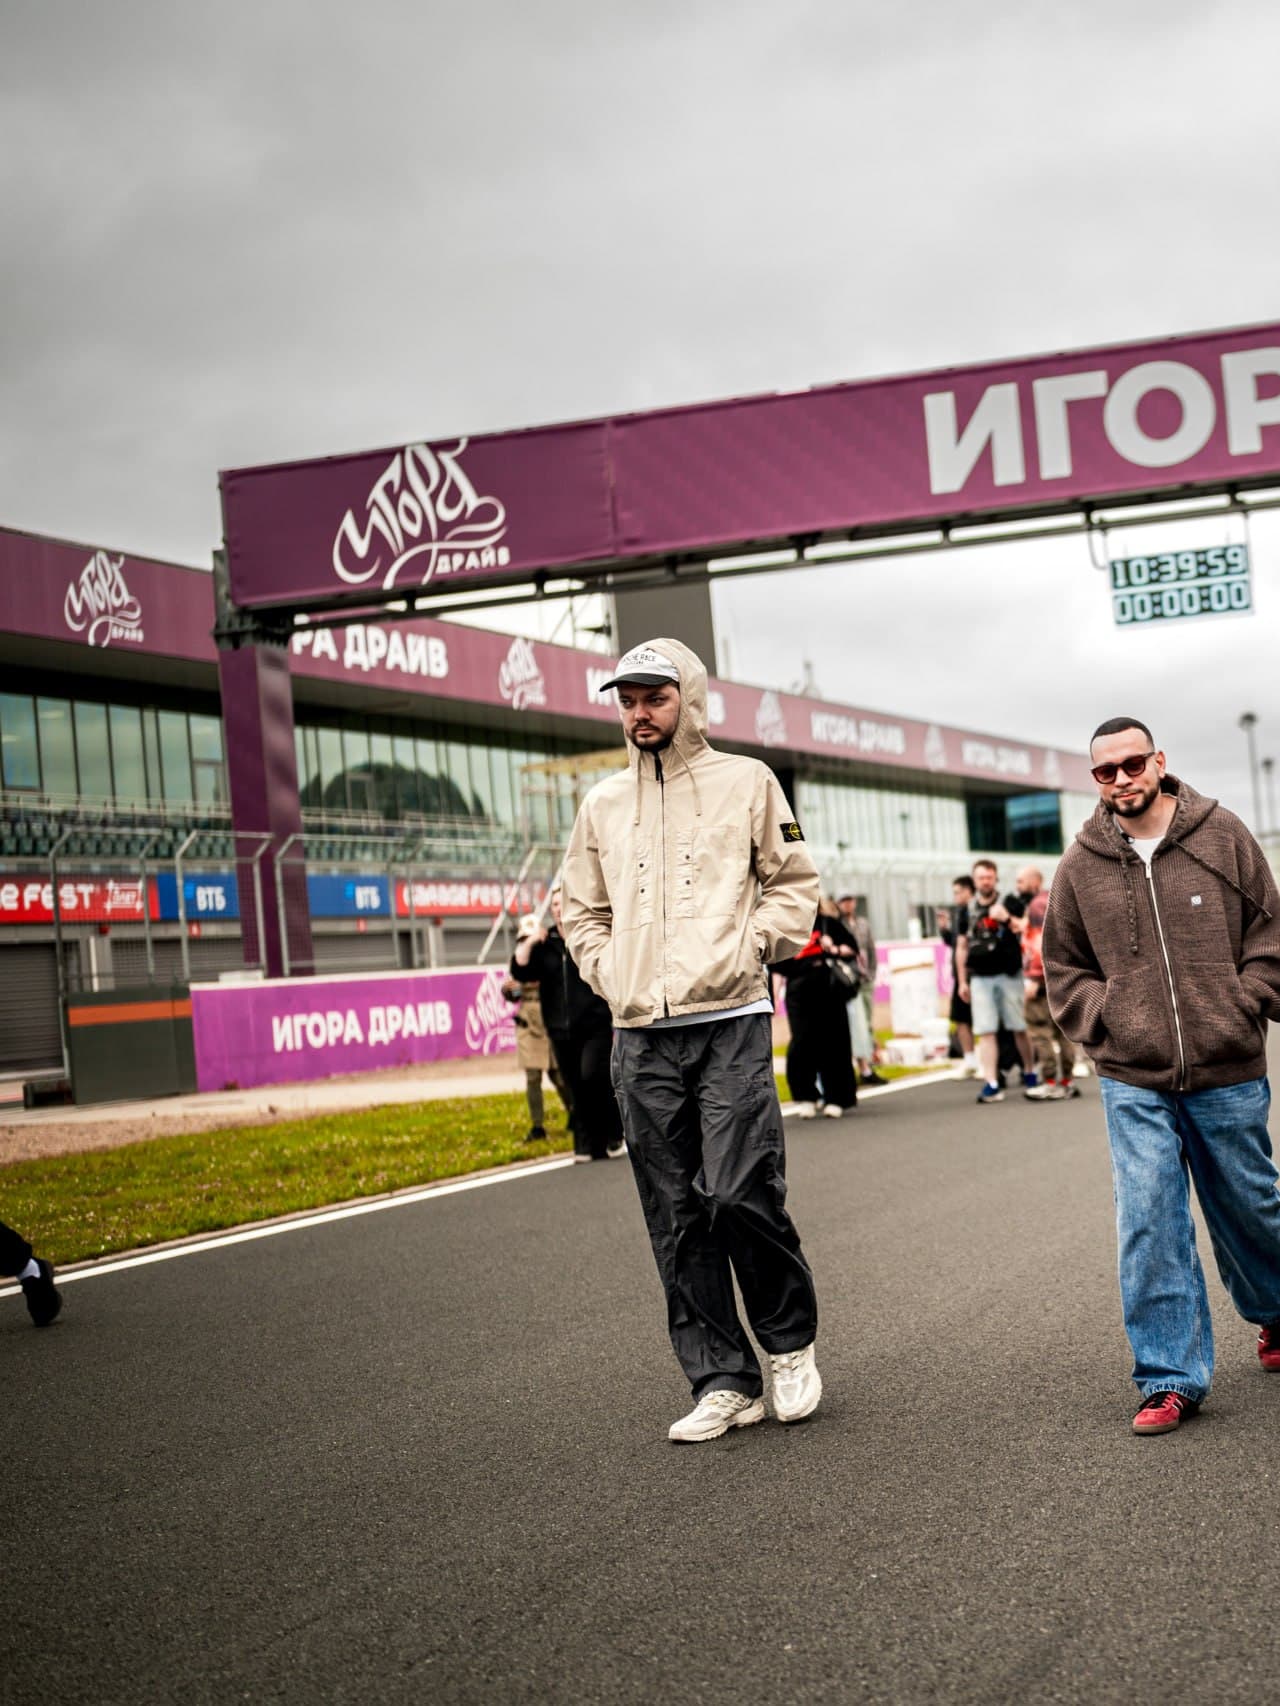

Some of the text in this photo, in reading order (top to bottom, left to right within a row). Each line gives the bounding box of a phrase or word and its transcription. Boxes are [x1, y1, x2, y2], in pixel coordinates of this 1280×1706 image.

[436, 547, 510, 574] ДРАЙВ
[1113, 546, 1246, 588] 10:39:59
[1115, 580, 1250, 624] 00:00:00
[343, 624, 449, 678] ДРАЙВ
[196, 886, 226, 911] ВТБ
[272, 1001, 452, 1053] ИГОРА ДРАЙВ
